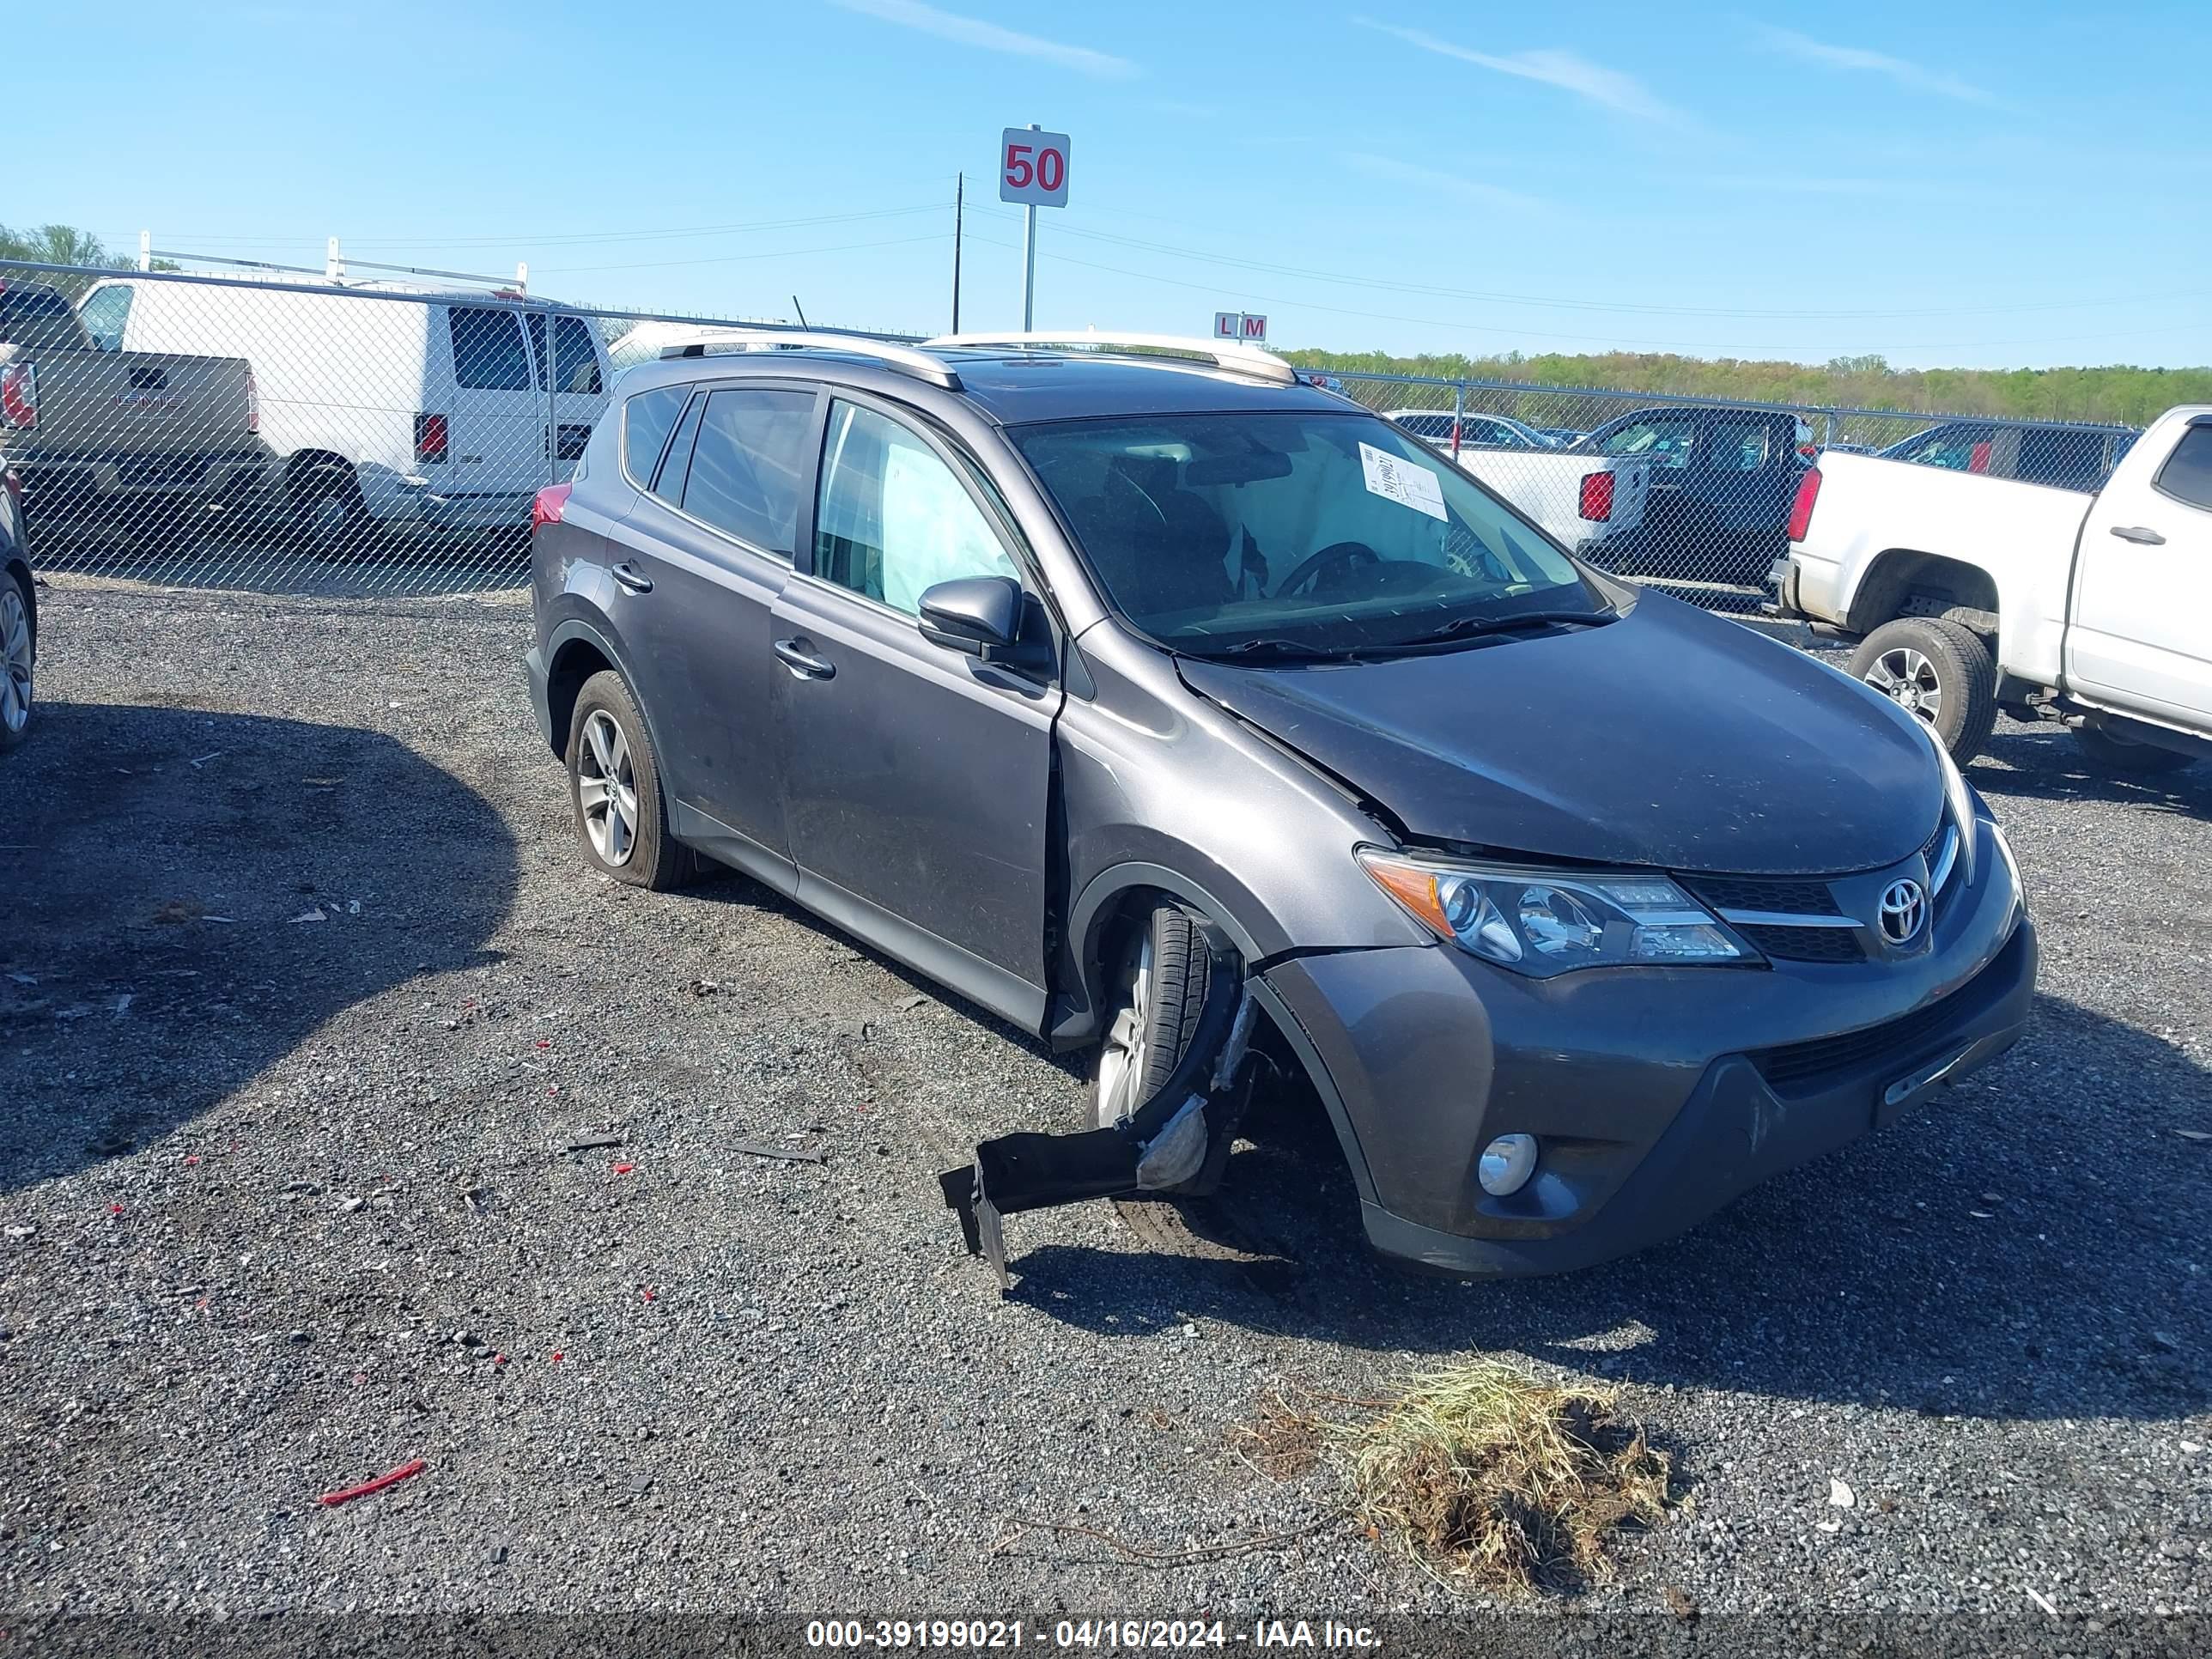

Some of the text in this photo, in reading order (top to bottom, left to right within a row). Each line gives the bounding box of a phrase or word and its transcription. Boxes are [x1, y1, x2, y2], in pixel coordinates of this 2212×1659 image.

[1006, 143, 1064, 191] 50
[1221, 317, 1231, 335] L
[1245, 318, 1264, 337] M
[116, 394, 186, 409] GMC
[1379, 455, 1400, 498] 39199021
